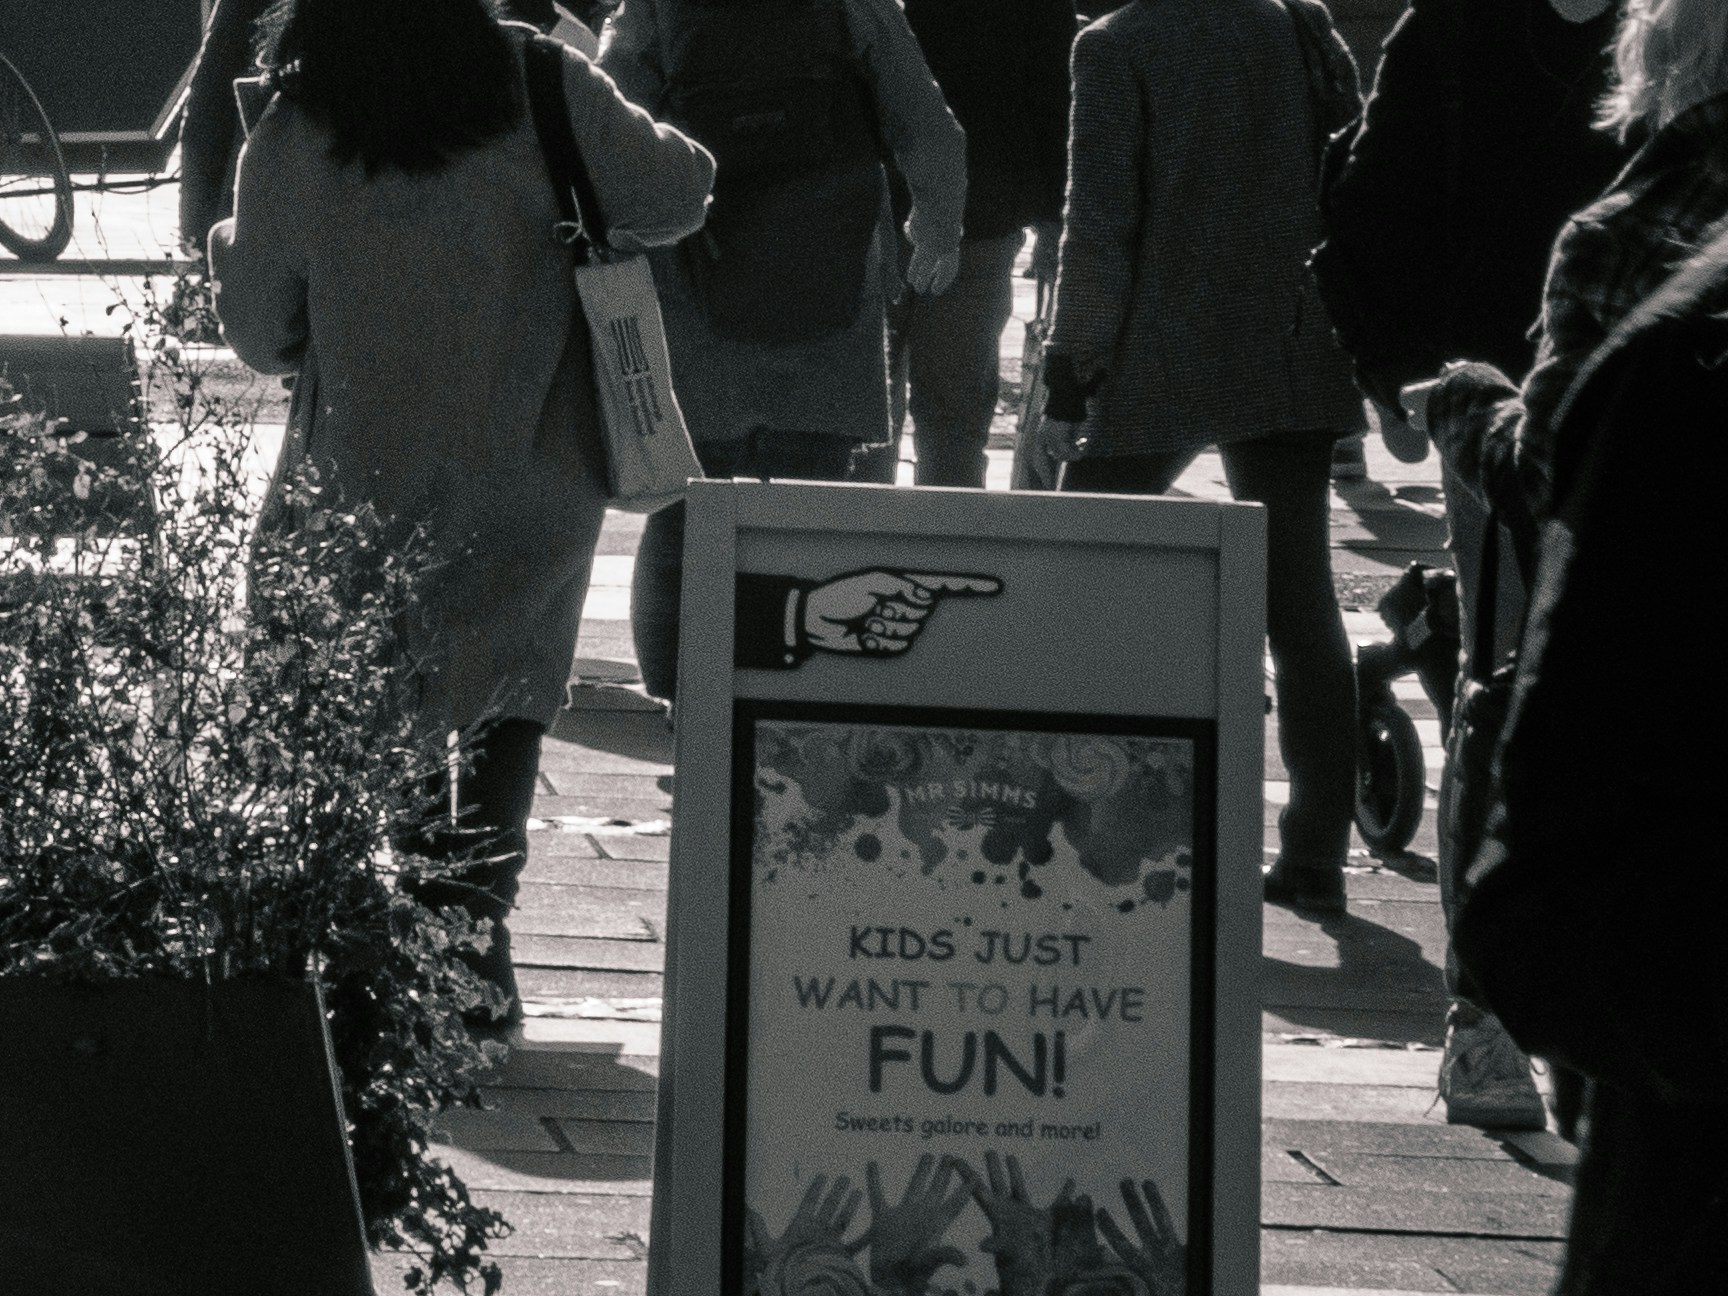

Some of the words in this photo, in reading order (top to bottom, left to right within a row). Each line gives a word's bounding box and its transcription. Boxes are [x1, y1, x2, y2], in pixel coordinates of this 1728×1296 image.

[906, 781, 945, 806] MR
[952, 779, 1037, 810] SIMMS
[849, 925, 956, 962] KIDS
[974, 930, 1093, 967] JUST
[793, 975, 931, 1012] WANT
[947, 981, 1010, 1015] TO
[1029, 984, 1146, 1024] HAVE
[869, 1025, 1067, 1100] FUN!
[834, 1110, 915, 1134] Sweets
[920, 1116, 989, 1140] galore
[994, 1118, 1035, 1139] and
[1040, 1121, 1102, 1141] more!
